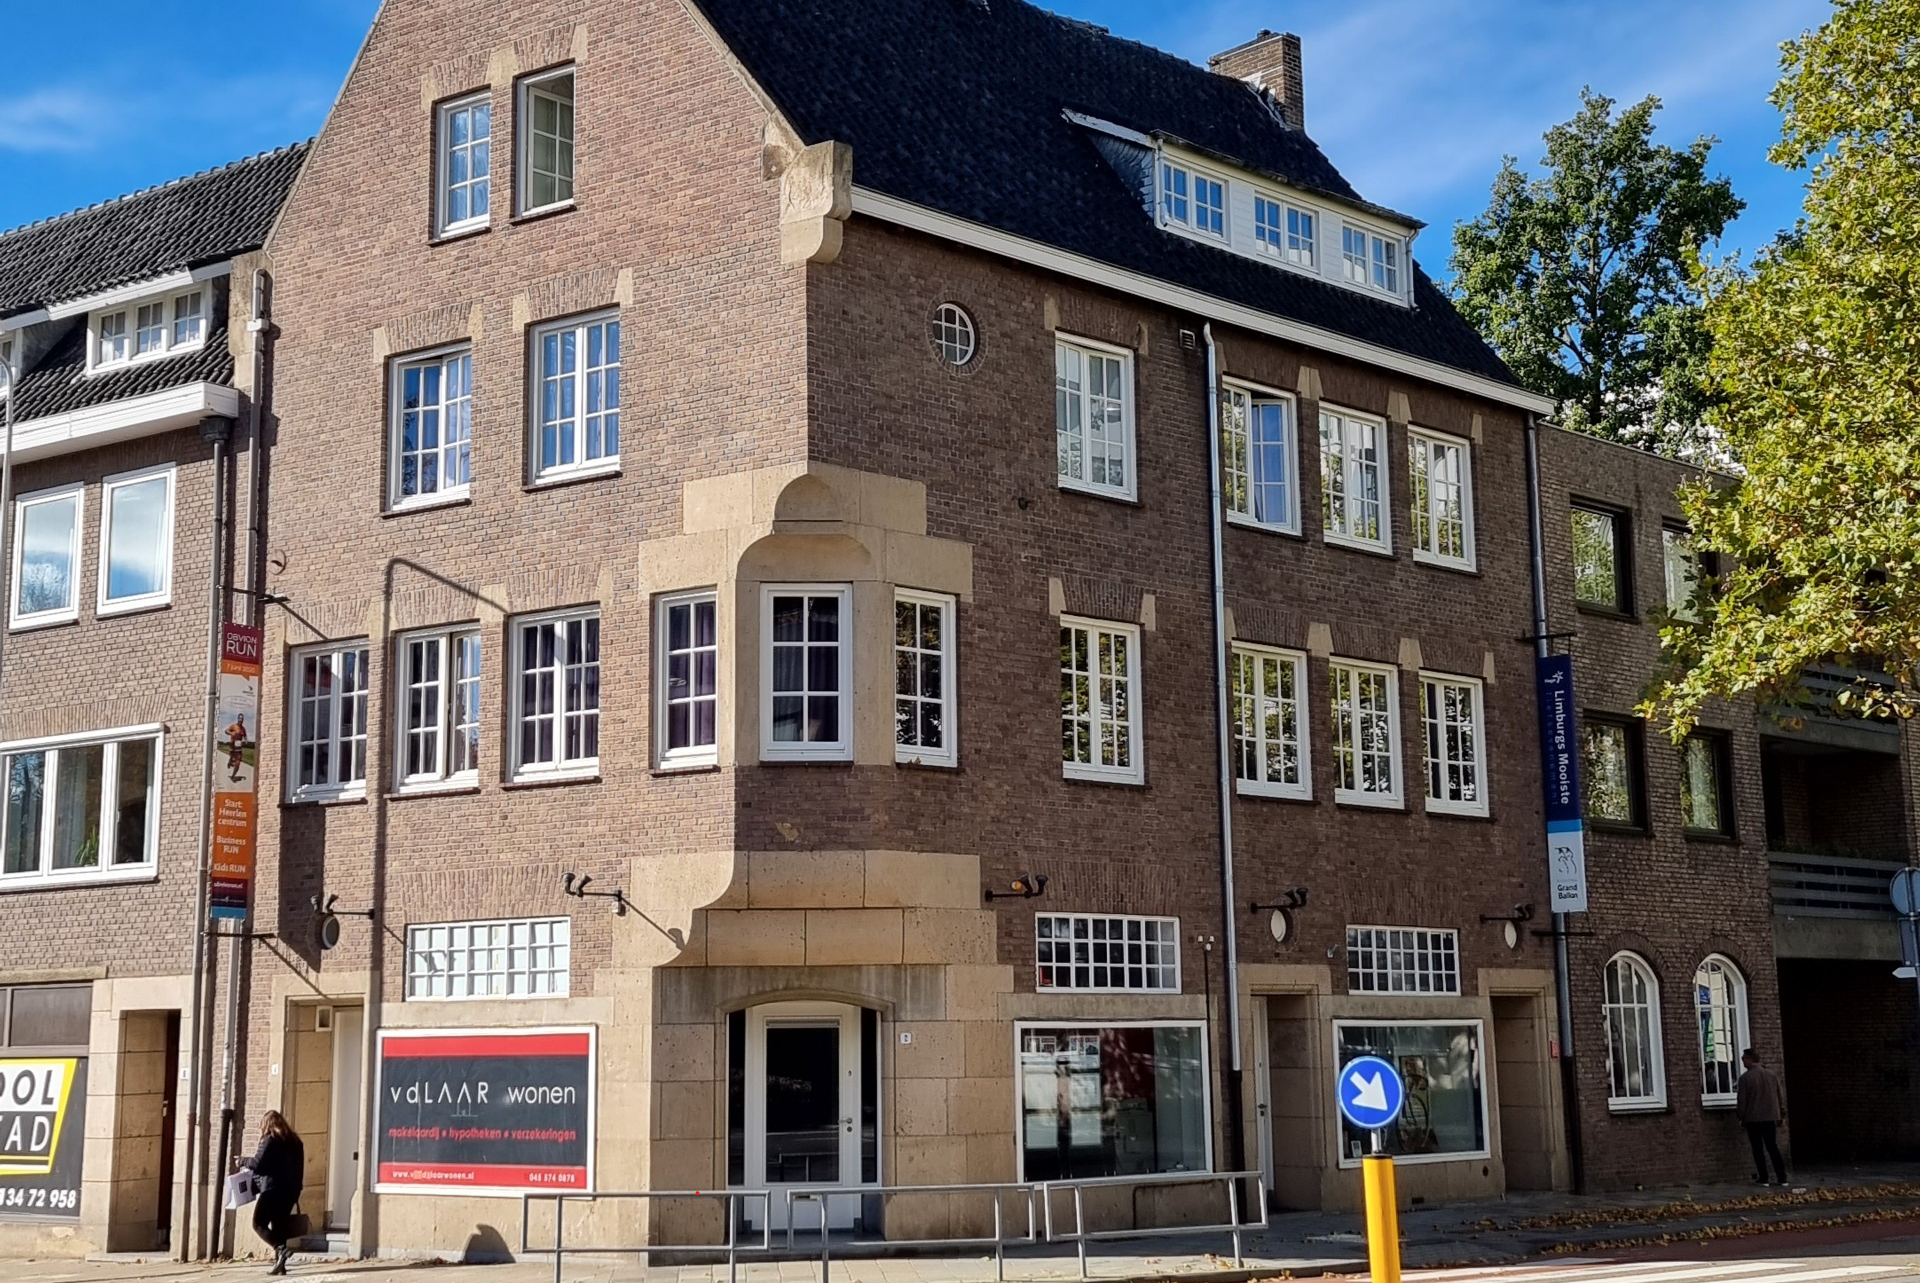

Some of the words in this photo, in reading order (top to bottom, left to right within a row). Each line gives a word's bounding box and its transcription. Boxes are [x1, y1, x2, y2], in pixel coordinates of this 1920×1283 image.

[226, 640, 257, 657] RUN
[1554, 690, 1566, 750] Limburgs
[1558, 753, 1571, 805] Mooiste
[219, 808, 247, 818] Heerlen
[217, 818, 247, 827] centrum
[216, 835, 246, 846] Business
[223, 845, 239, 854] RUN
[214, 863, 228, 872] Kids
[229, 864, 246, 873] RUN
[0, 1069, 53, 1106] OL
[508, 1085, 576, 1104] wonen
[0, 1115, 50, 1151] AD
[388, 1126, 440, 1141] makelaardij
[449, 1126, 501, 1141] hypotheken
[511, 1127, 576, 1143] verzekeringen
[27, 1188, 46, 1207] 72
[49, 1189, 76, 1209] 958
